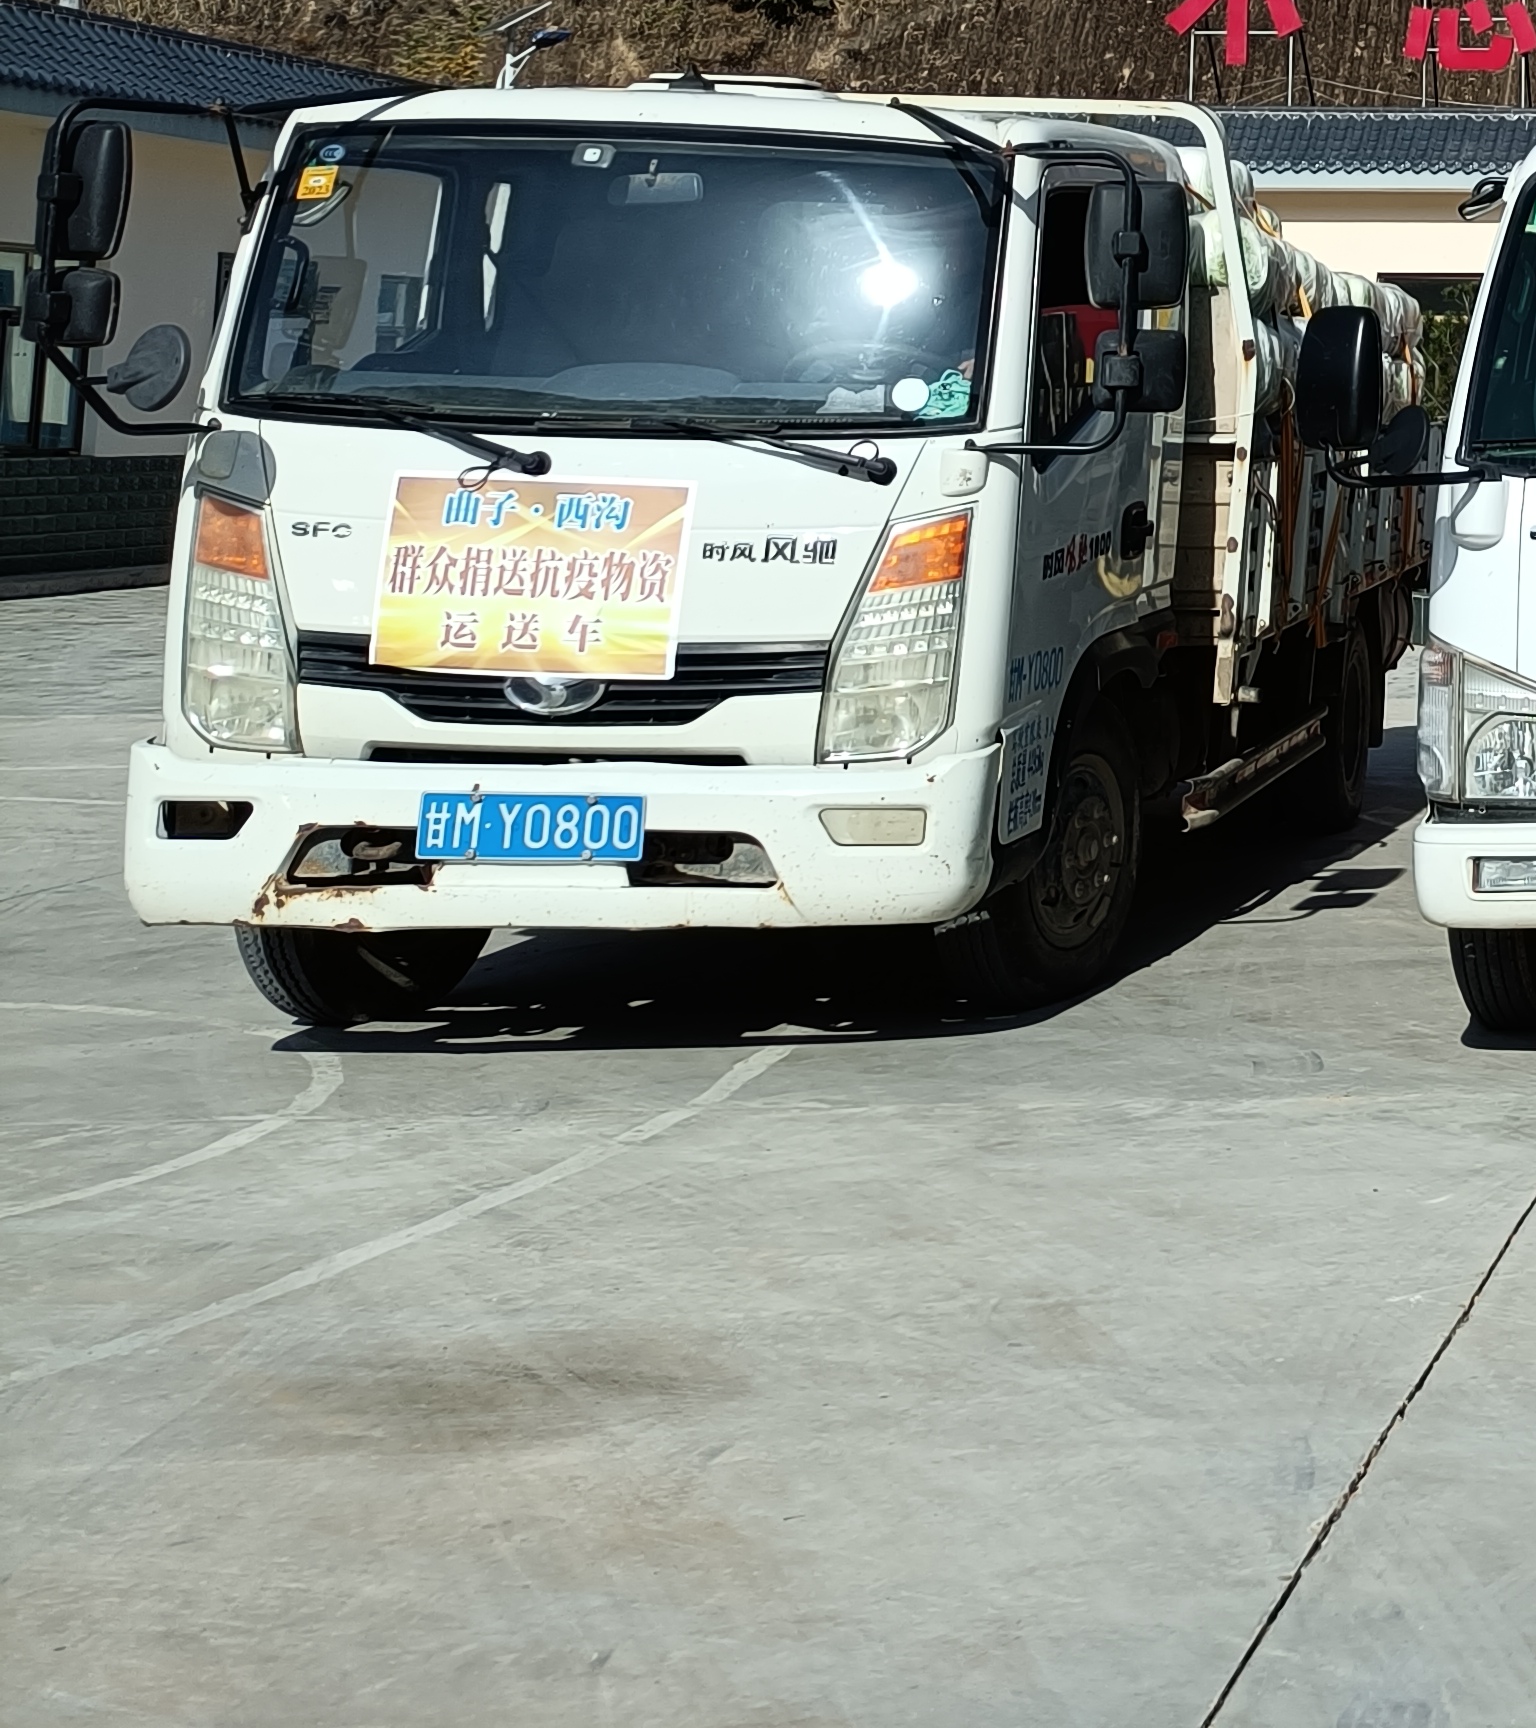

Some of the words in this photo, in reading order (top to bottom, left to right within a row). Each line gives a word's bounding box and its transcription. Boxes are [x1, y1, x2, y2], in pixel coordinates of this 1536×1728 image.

[445, 490, 630, 531] 曲子·西沟
[389, 545, 674, 603] 群众捐送抗疫物资
[440, 611, 603, 652] 运送车
